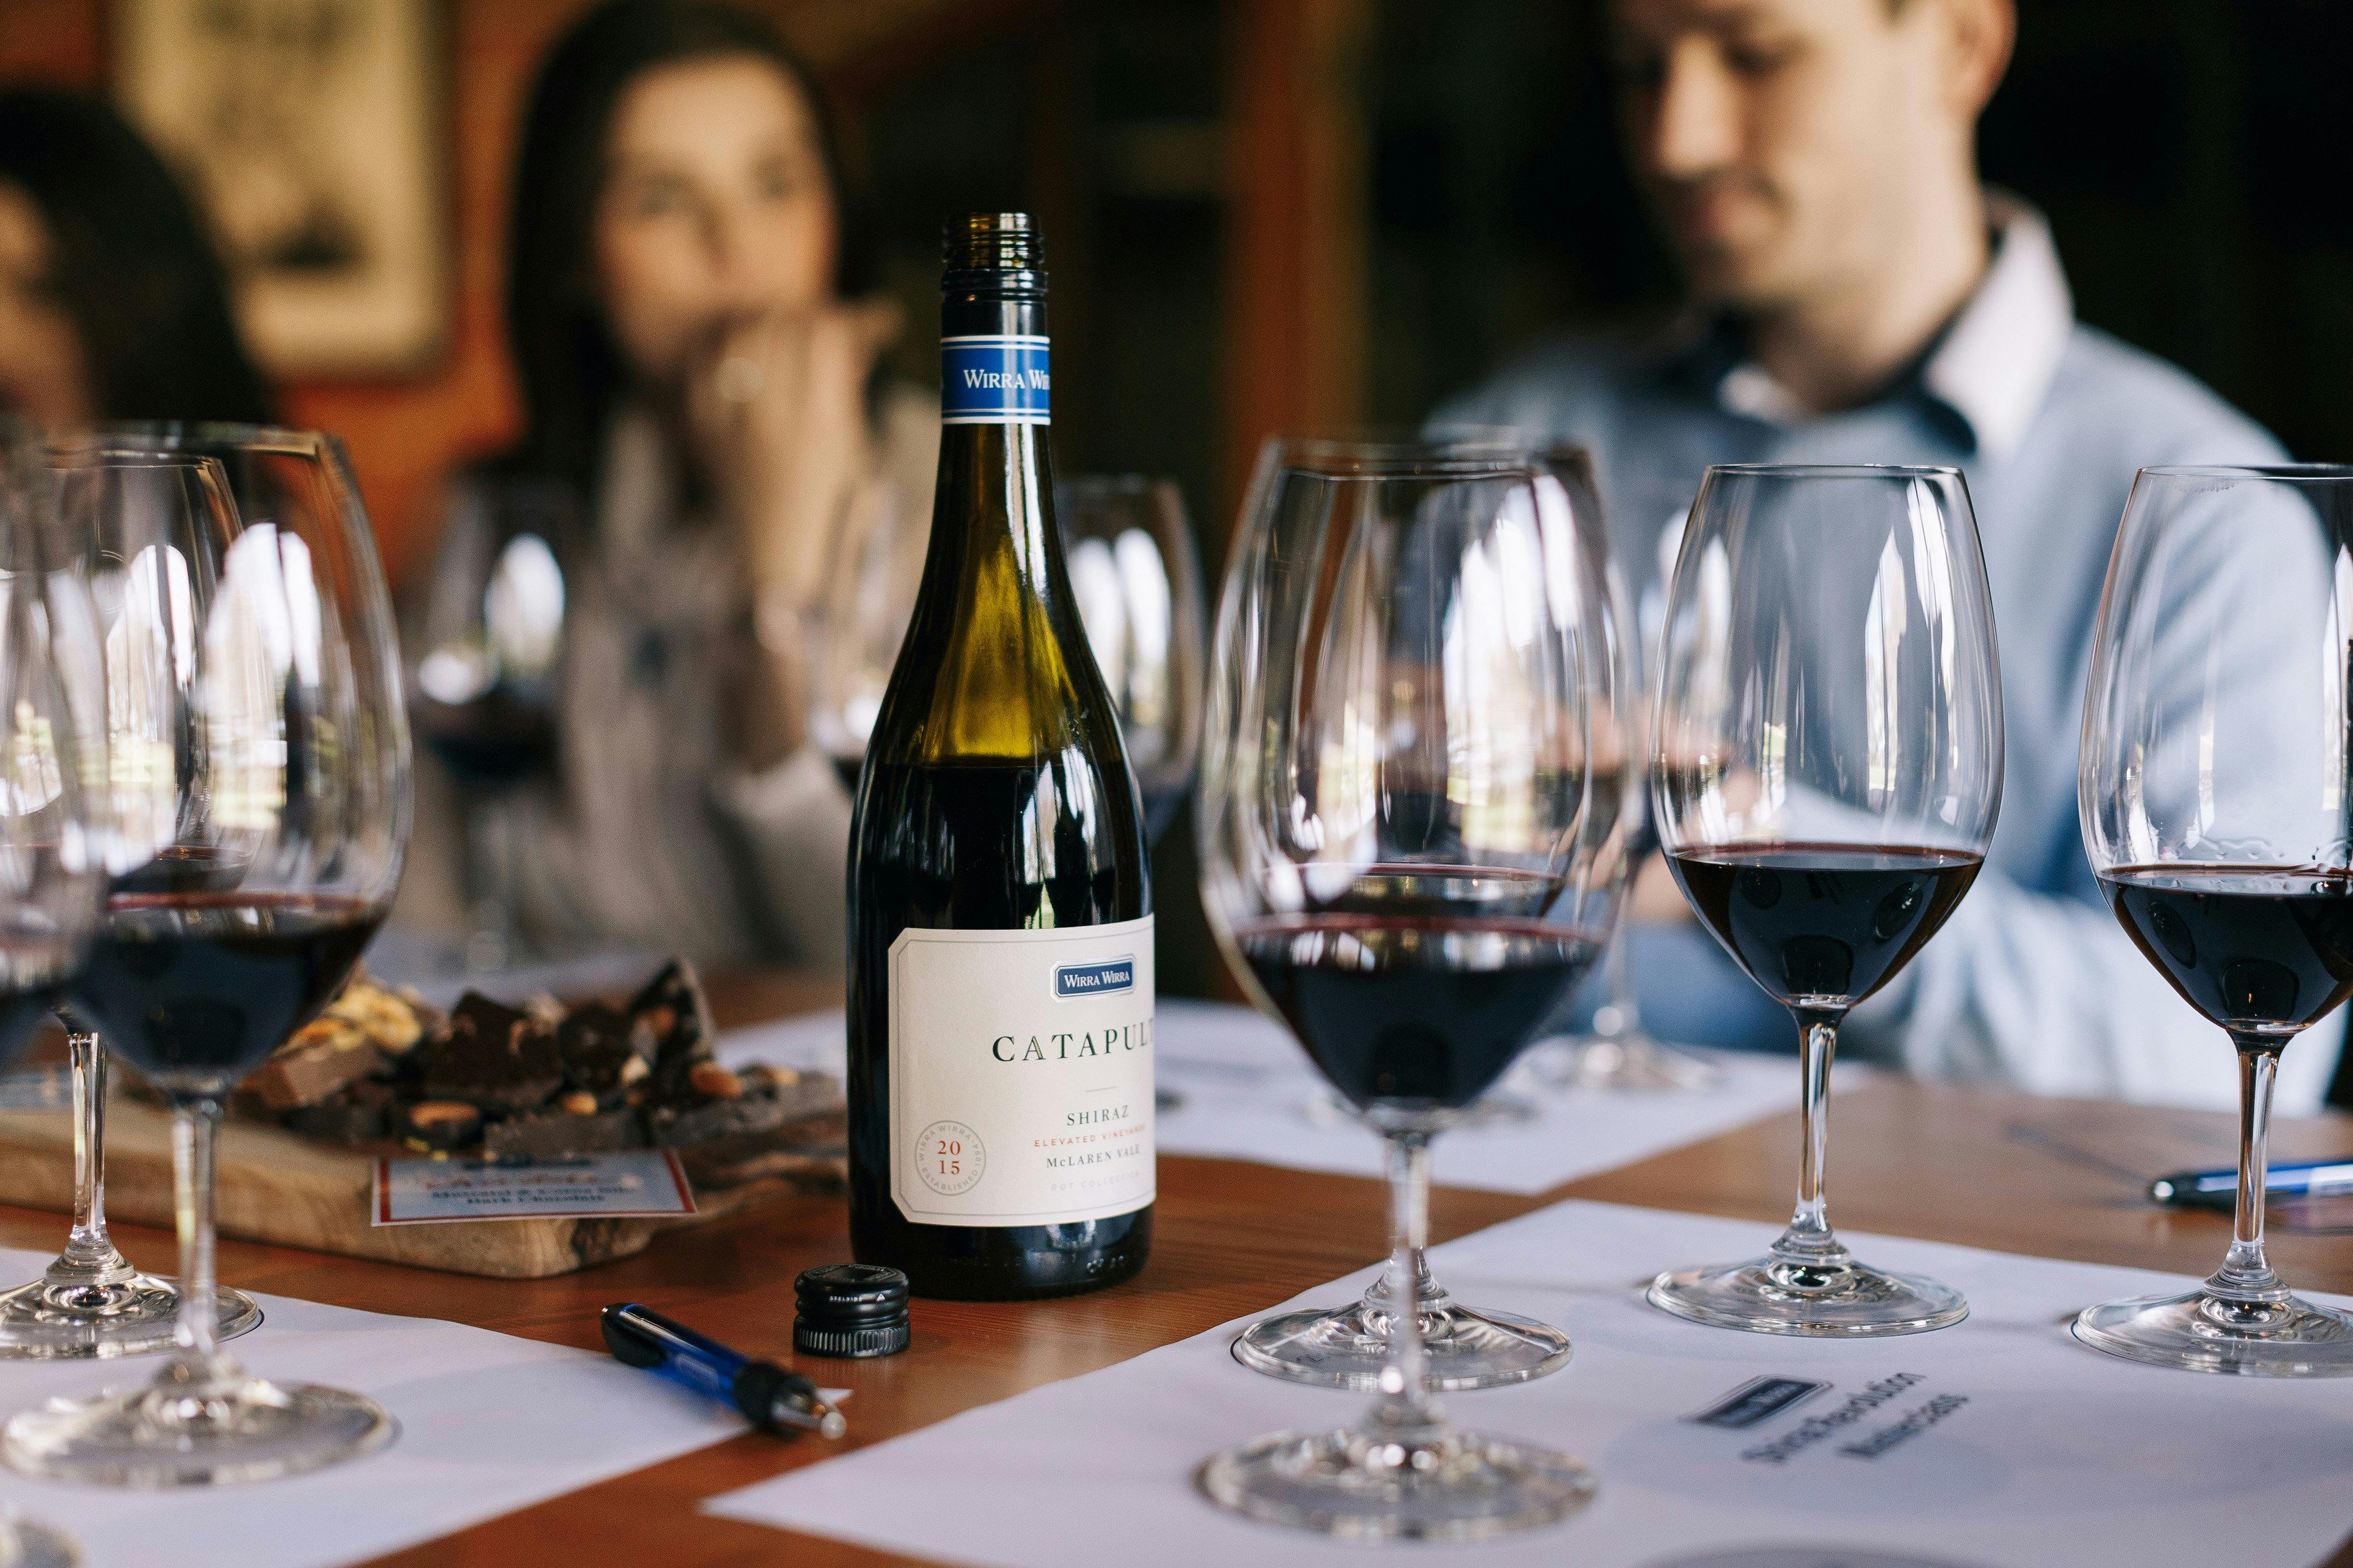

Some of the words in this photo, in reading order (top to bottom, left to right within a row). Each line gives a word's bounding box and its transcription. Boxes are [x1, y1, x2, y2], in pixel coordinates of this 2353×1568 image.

[1066, 1104, 1130, 1126] SHIRAZ
[937, 1140, 961, 1155] 20
[1034, 1135, 1096, 1147] ELEVATED
[1046, 1150, 1112, 1168] McLAREN
[1116, 1143, 1139, 1158] VALE
[939, 1160, 960, 1175] 15
